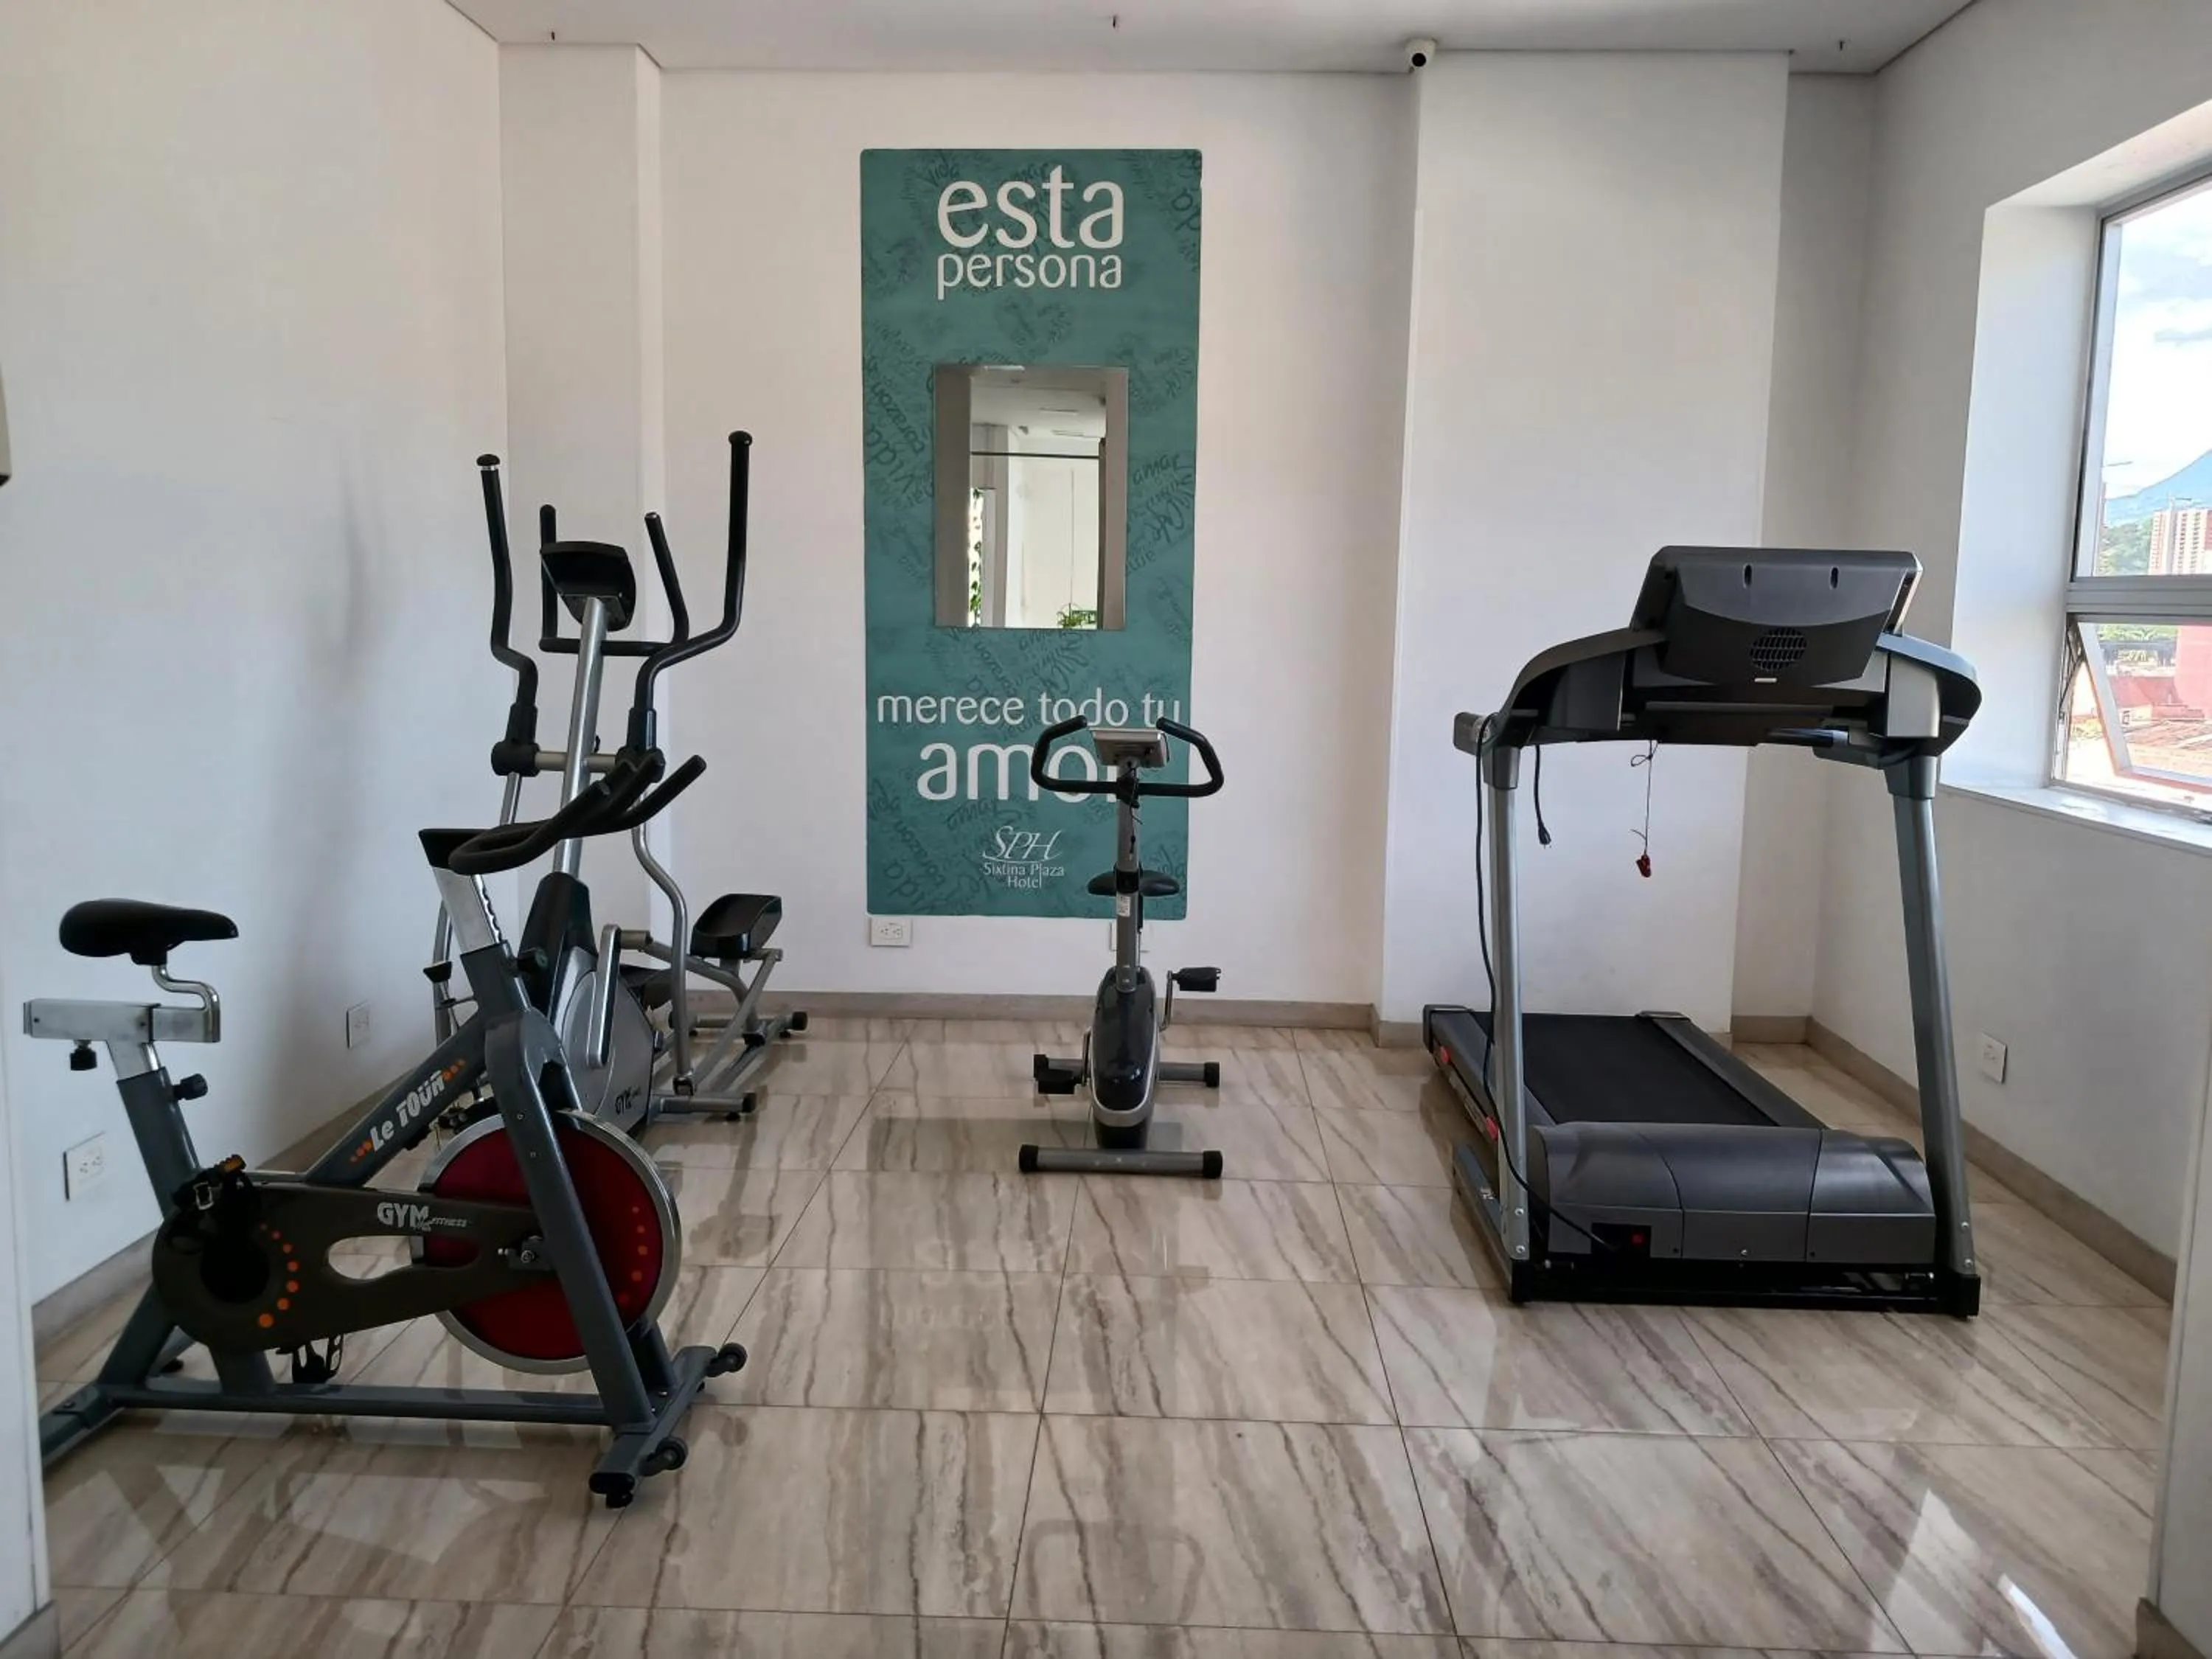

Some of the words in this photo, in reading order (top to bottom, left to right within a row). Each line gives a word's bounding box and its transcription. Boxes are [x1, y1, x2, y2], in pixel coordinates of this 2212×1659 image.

[937, 164, 1124, 249] esta
[936, 253, 1122, 301] persona
[877, 695, 1025, 725] merece
[1037, 687, 1129, 726] todo
[1141, 690, 1180, 726] tu
[984, 825, 1063, 861] SPH
[983, 862, 1026, 876] Sixtina
[1030, 862, 1065, 877] Plaza
[1007, 875, 1042, 888] Hotel
[370, 1120, 394, 1152] Le
[377, 1202, 430, 1228] GYM
